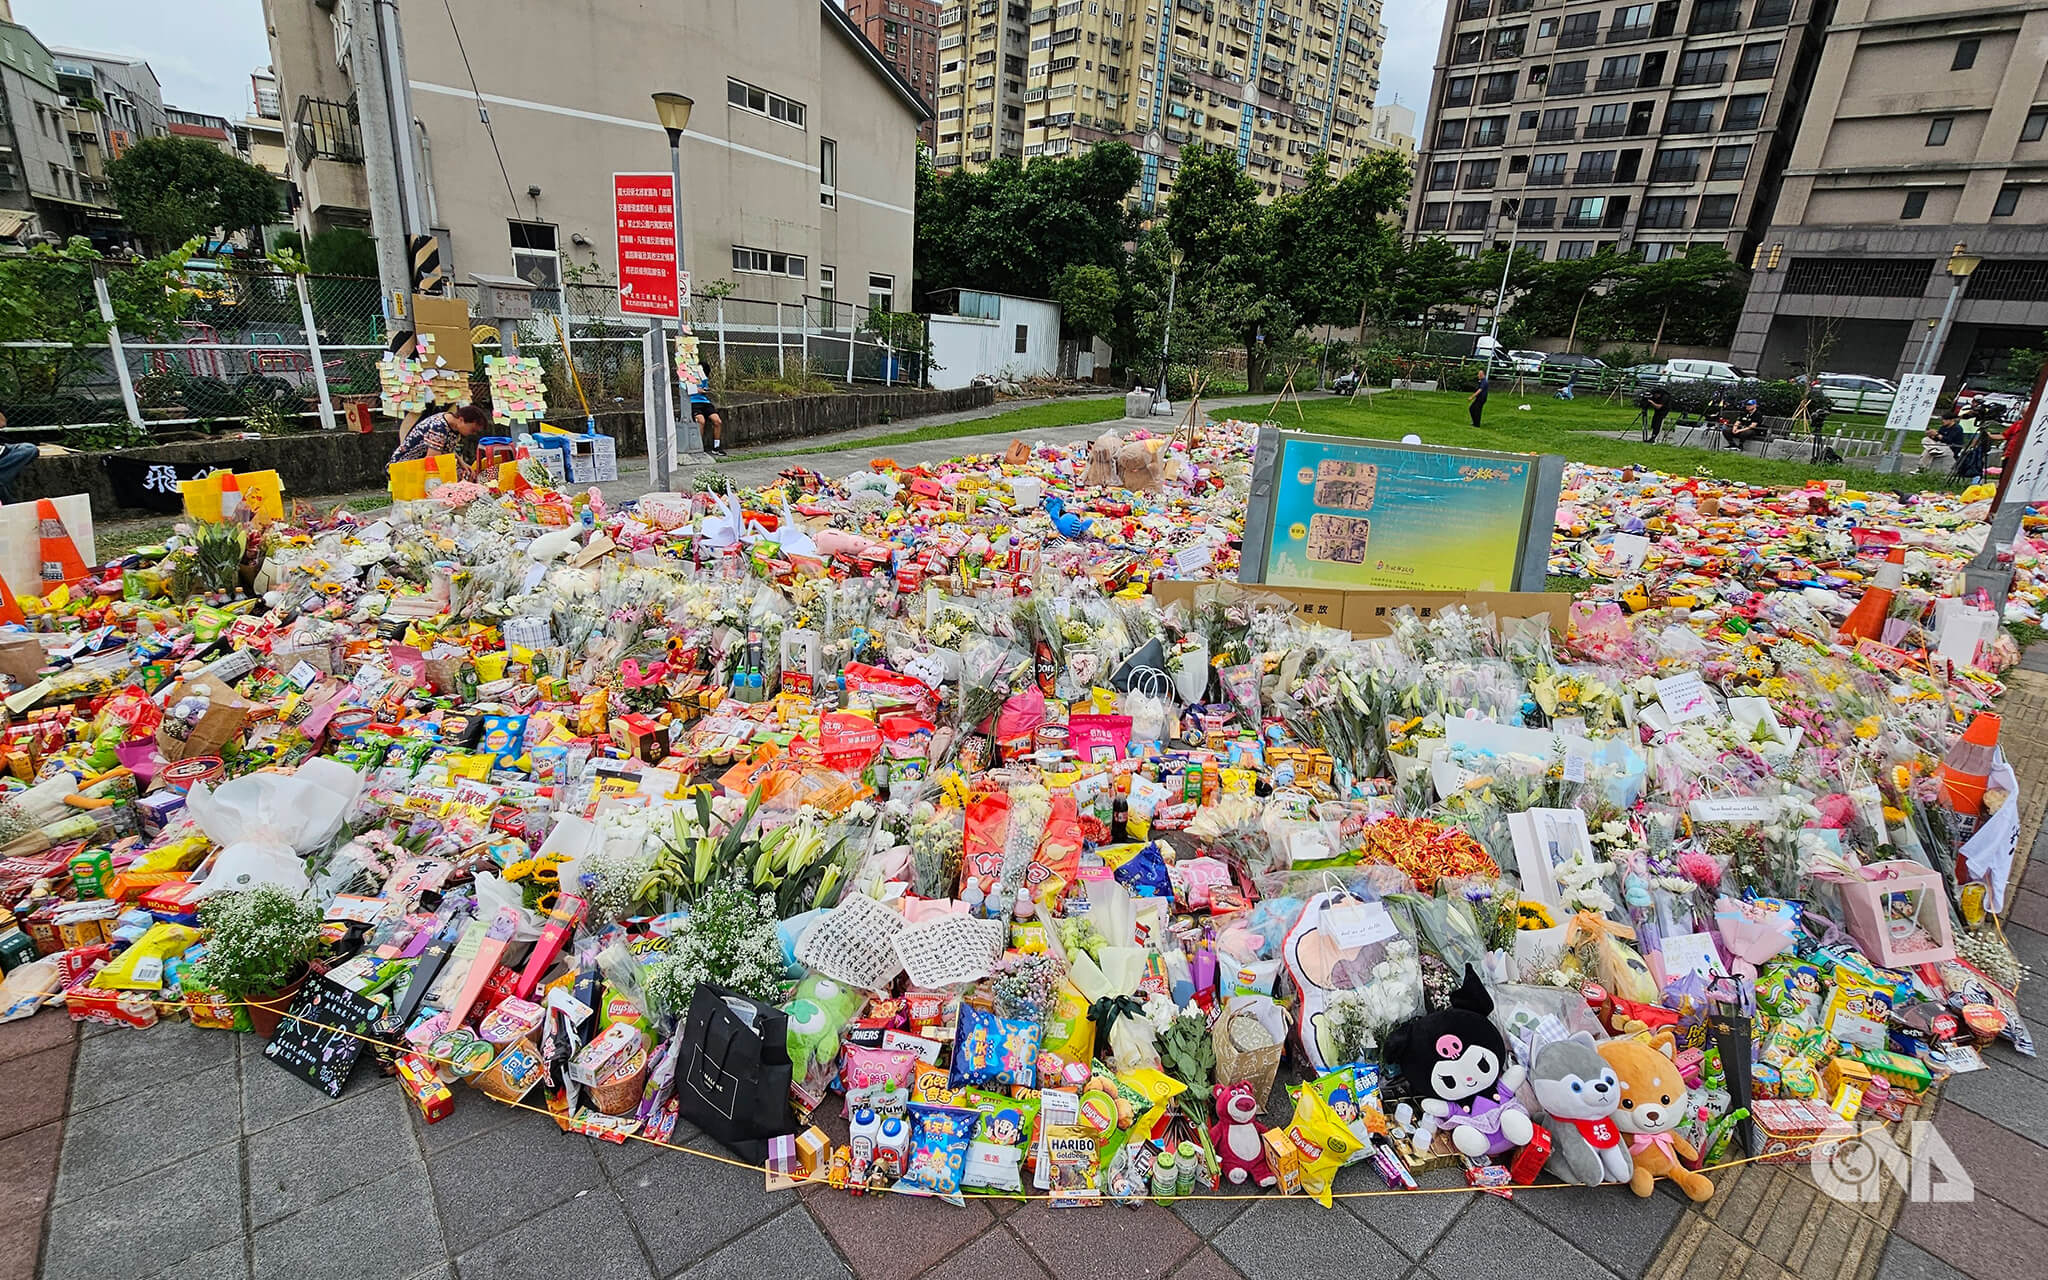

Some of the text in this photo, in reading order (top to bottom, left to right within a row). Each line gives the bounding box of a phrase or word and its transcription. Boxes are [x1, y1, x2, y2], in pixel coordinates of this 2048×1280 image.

[1375, 606, 1431, 617] 請壓
[874, 1104, 903, 1116] Plum
[1051, 1138, 1095, 1152] HARIBO
[1056, 1150, 1090, 1161] Goldbears
